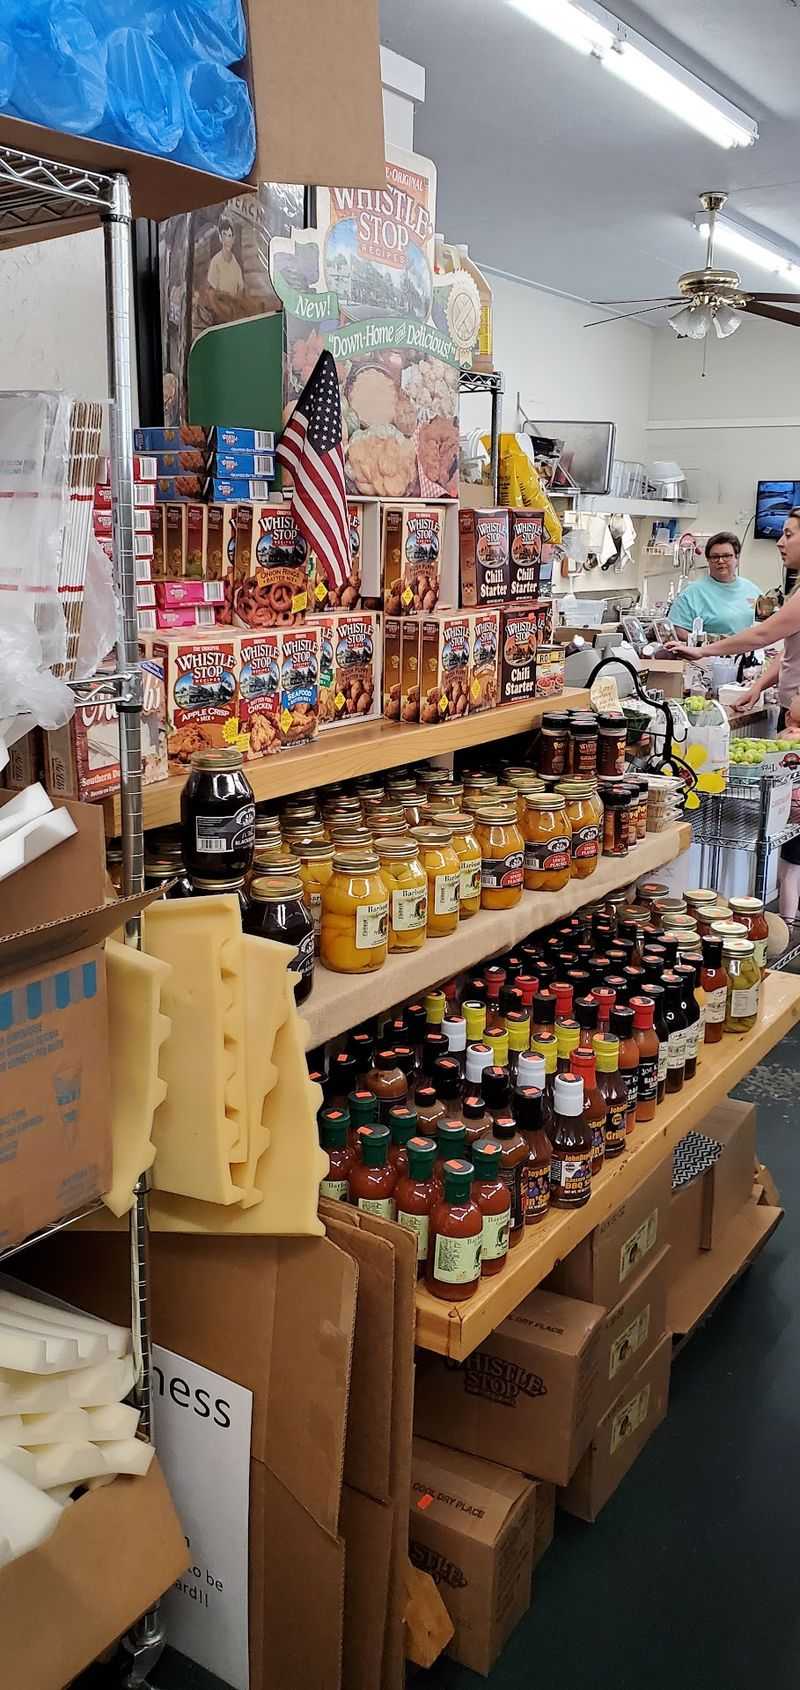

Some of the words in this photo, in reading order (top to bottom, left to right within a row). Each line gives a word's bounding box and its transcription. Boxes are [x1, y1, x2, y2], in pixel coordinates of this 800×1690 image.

[329, 187, 434, 240] WHISTLE
[359, 211, 409, 252] STOP
[295, 296, 331, 319] New!
[407, 518, 440, 533] WHISTLE
[513, 522, 543, 536] WHISTLE
[273, 529, 298, 541] STOP
[416, 529, 433, 540] STOP
[485, 569, 503, 584] Chili
[516, 568, 534, 581] Chili
[480, 583, 507, 598] Starter
[511, 581, 537, 594] Starter
[337, 622, 375, 638] WHISTLE
[443, 626, 470, 643] WHISTLE
[475, 621, 498, 634] WHISTLE
[506, 621, 538, 636] WHISTLE
[347, 634, 366, 644] STOP
[240, 644, 280, 662] WHISTLE
[283, 639, 319, 657] WHISTLE
[176, 651, 238, 672] WHISTLE
[251, 657, 272, 670] STOP
[292, 651, 311, 663] STOP
[194, 665, 224, 679] STOP
[511, 666, 530, 682] Chili
[287, 689, 312, 700] SEAFOOD
[505, 681, 534, 696] Starter
[182, 709, 208, 722] APPLE
[208, 706, 230, 716] CRISP
[248, 702, 273, 714] CHICKEN
[565, 1181, 583, 1190] BBQ
[465, 1370, 521, 1400] STOP
[412, 1481, 435, 1498] COOL
[437, 1491, 457, 1505] DRY
[455, 1500, 486, 1520] PLACE
[206, 1569, 224, 1592] be
